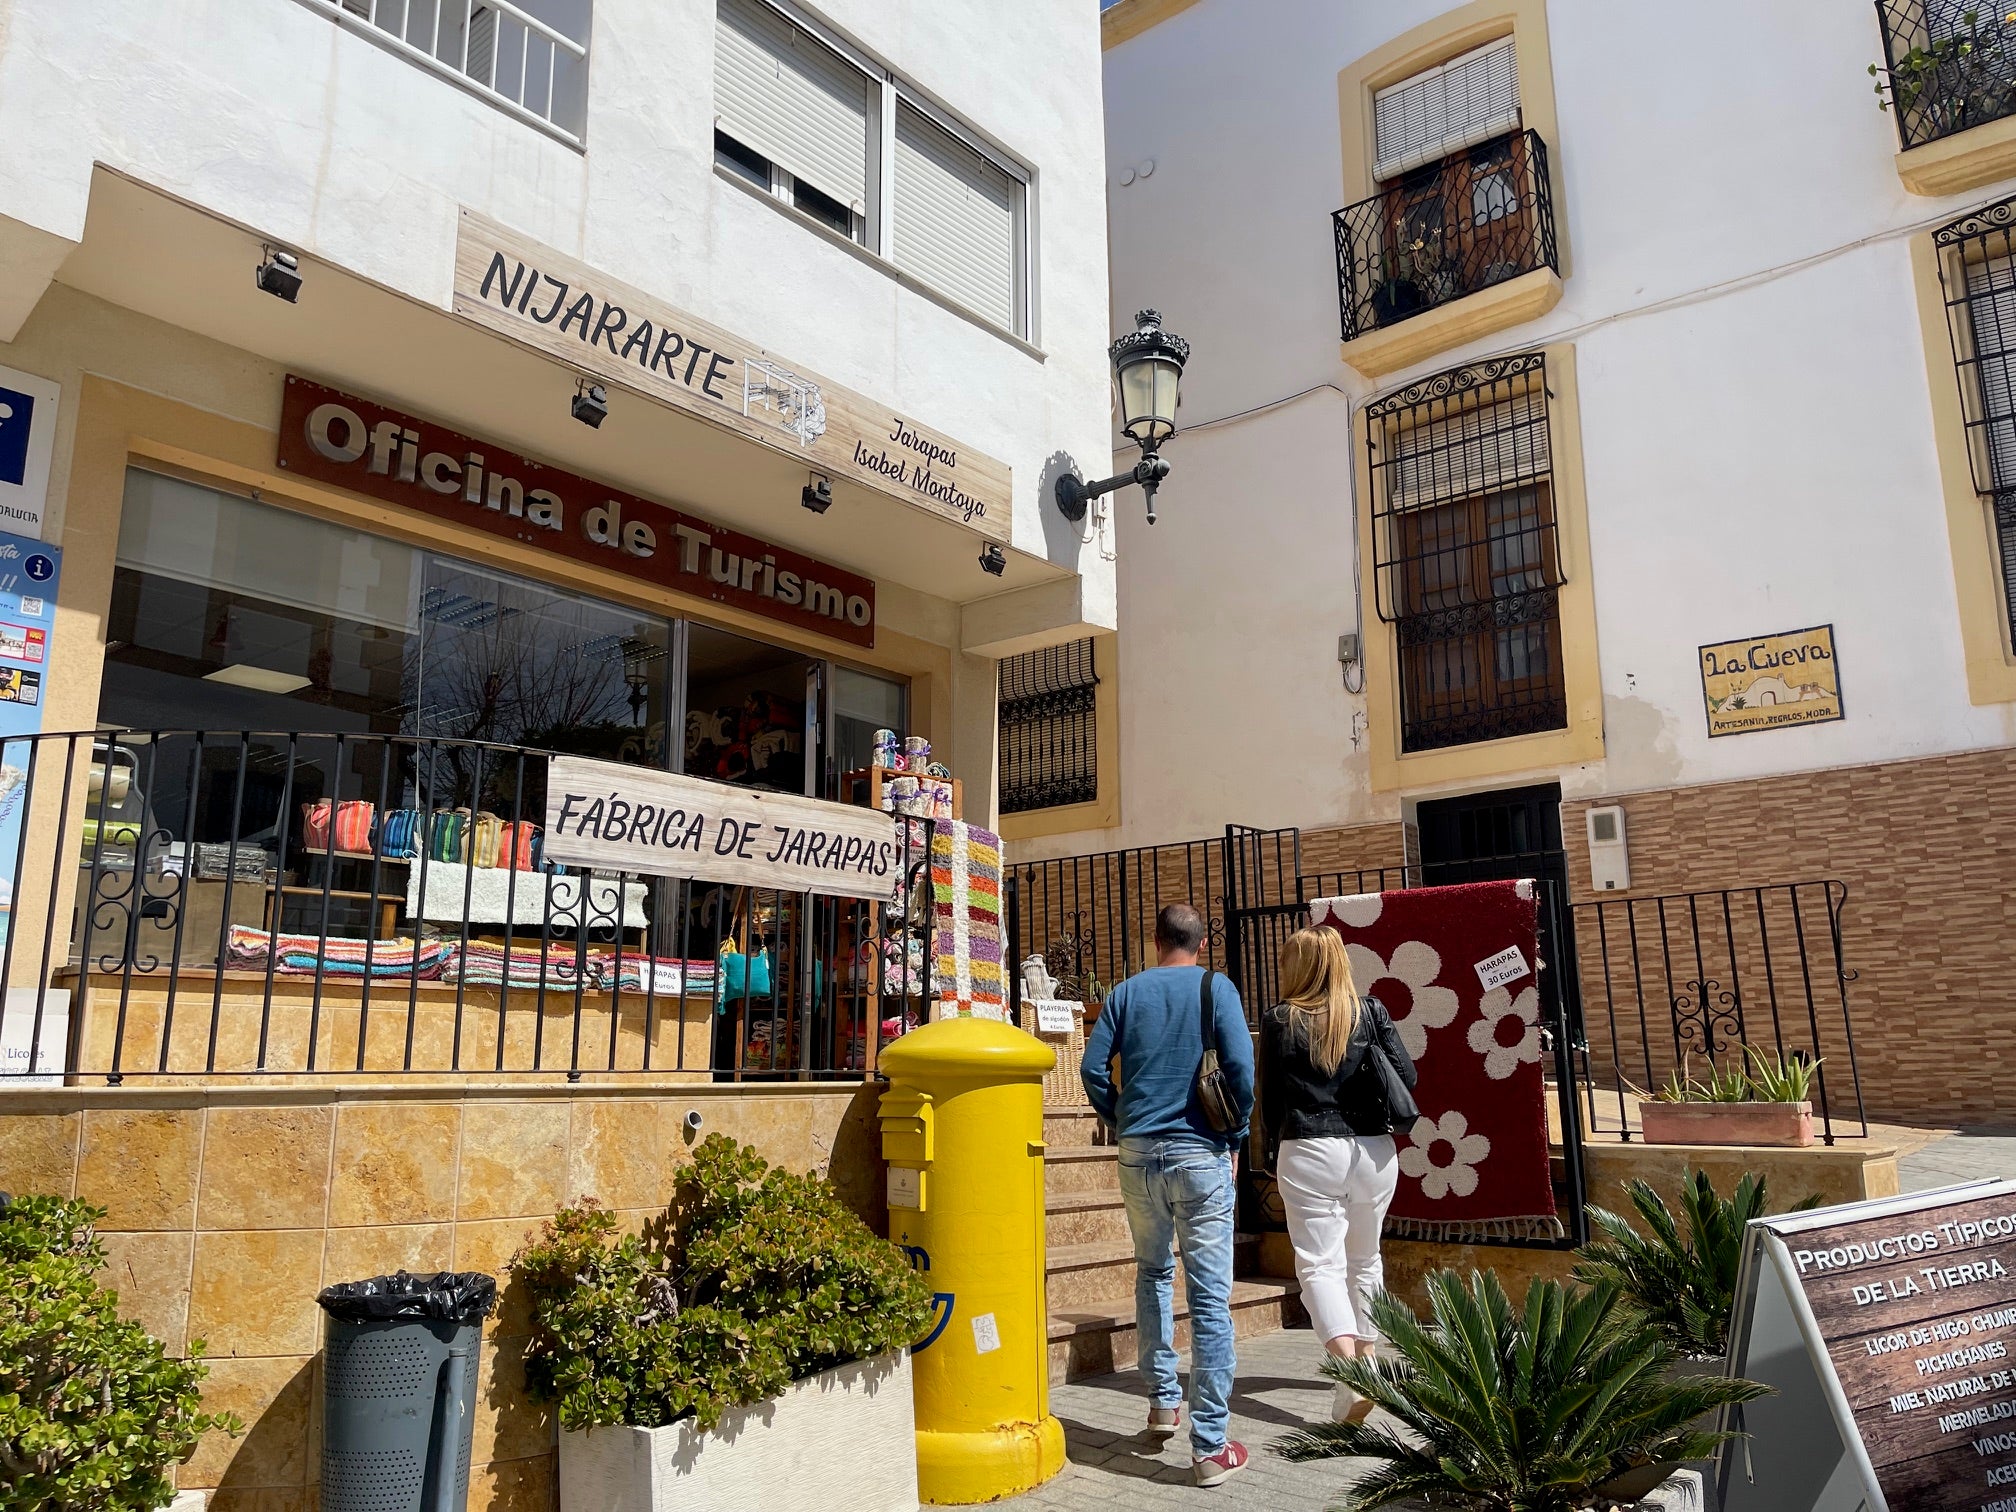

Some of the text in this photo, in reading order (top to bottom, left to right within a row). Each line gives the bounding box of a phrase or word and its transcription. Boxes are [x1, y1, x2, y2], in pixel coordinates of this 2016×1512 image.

[480, 251, 735, 401] NIJARARTE
[889, 418, 956, 468] Jarapas
[853, 439, 987, 522] Isabel Montoya
[306, 403, 871, 627] Oficina de Turismo
[1705, 643, 1831, 677] La Cueva
[556, 792, 892, 877] FÁBRICA DE JARAPAS
[644, 968, 677, 980] HRAPAS
[1480, 950, 1518, 973] HARAPAS
[1487, 975, 1499, 986] 30
[1499, 965, 1523, 980] Euros
[655, 981, 675, 990] Euros
[1040, 1004, 1070, 1012] PLAYERAS
[8, 1048, 46, 1059] Licos
[1794, 1230, 1939, 1274] PRODUCTOS
[1852, 1258, 2008, 1305] DE LA TIERRA
[1864, 1333, 1910, 1356] LICOR
[1910, 1327, 1932, 1347] DE
[1931, 1320, 1971, 1341] HIGO
[1914, 1340, 2008, 1376] PICHICHANES
[1889, 1390, 1926, 1415] MIEL
[1923, 1376, 1991, 1406] NATURAL
[1990, 1370, 2013, 1389] DE
